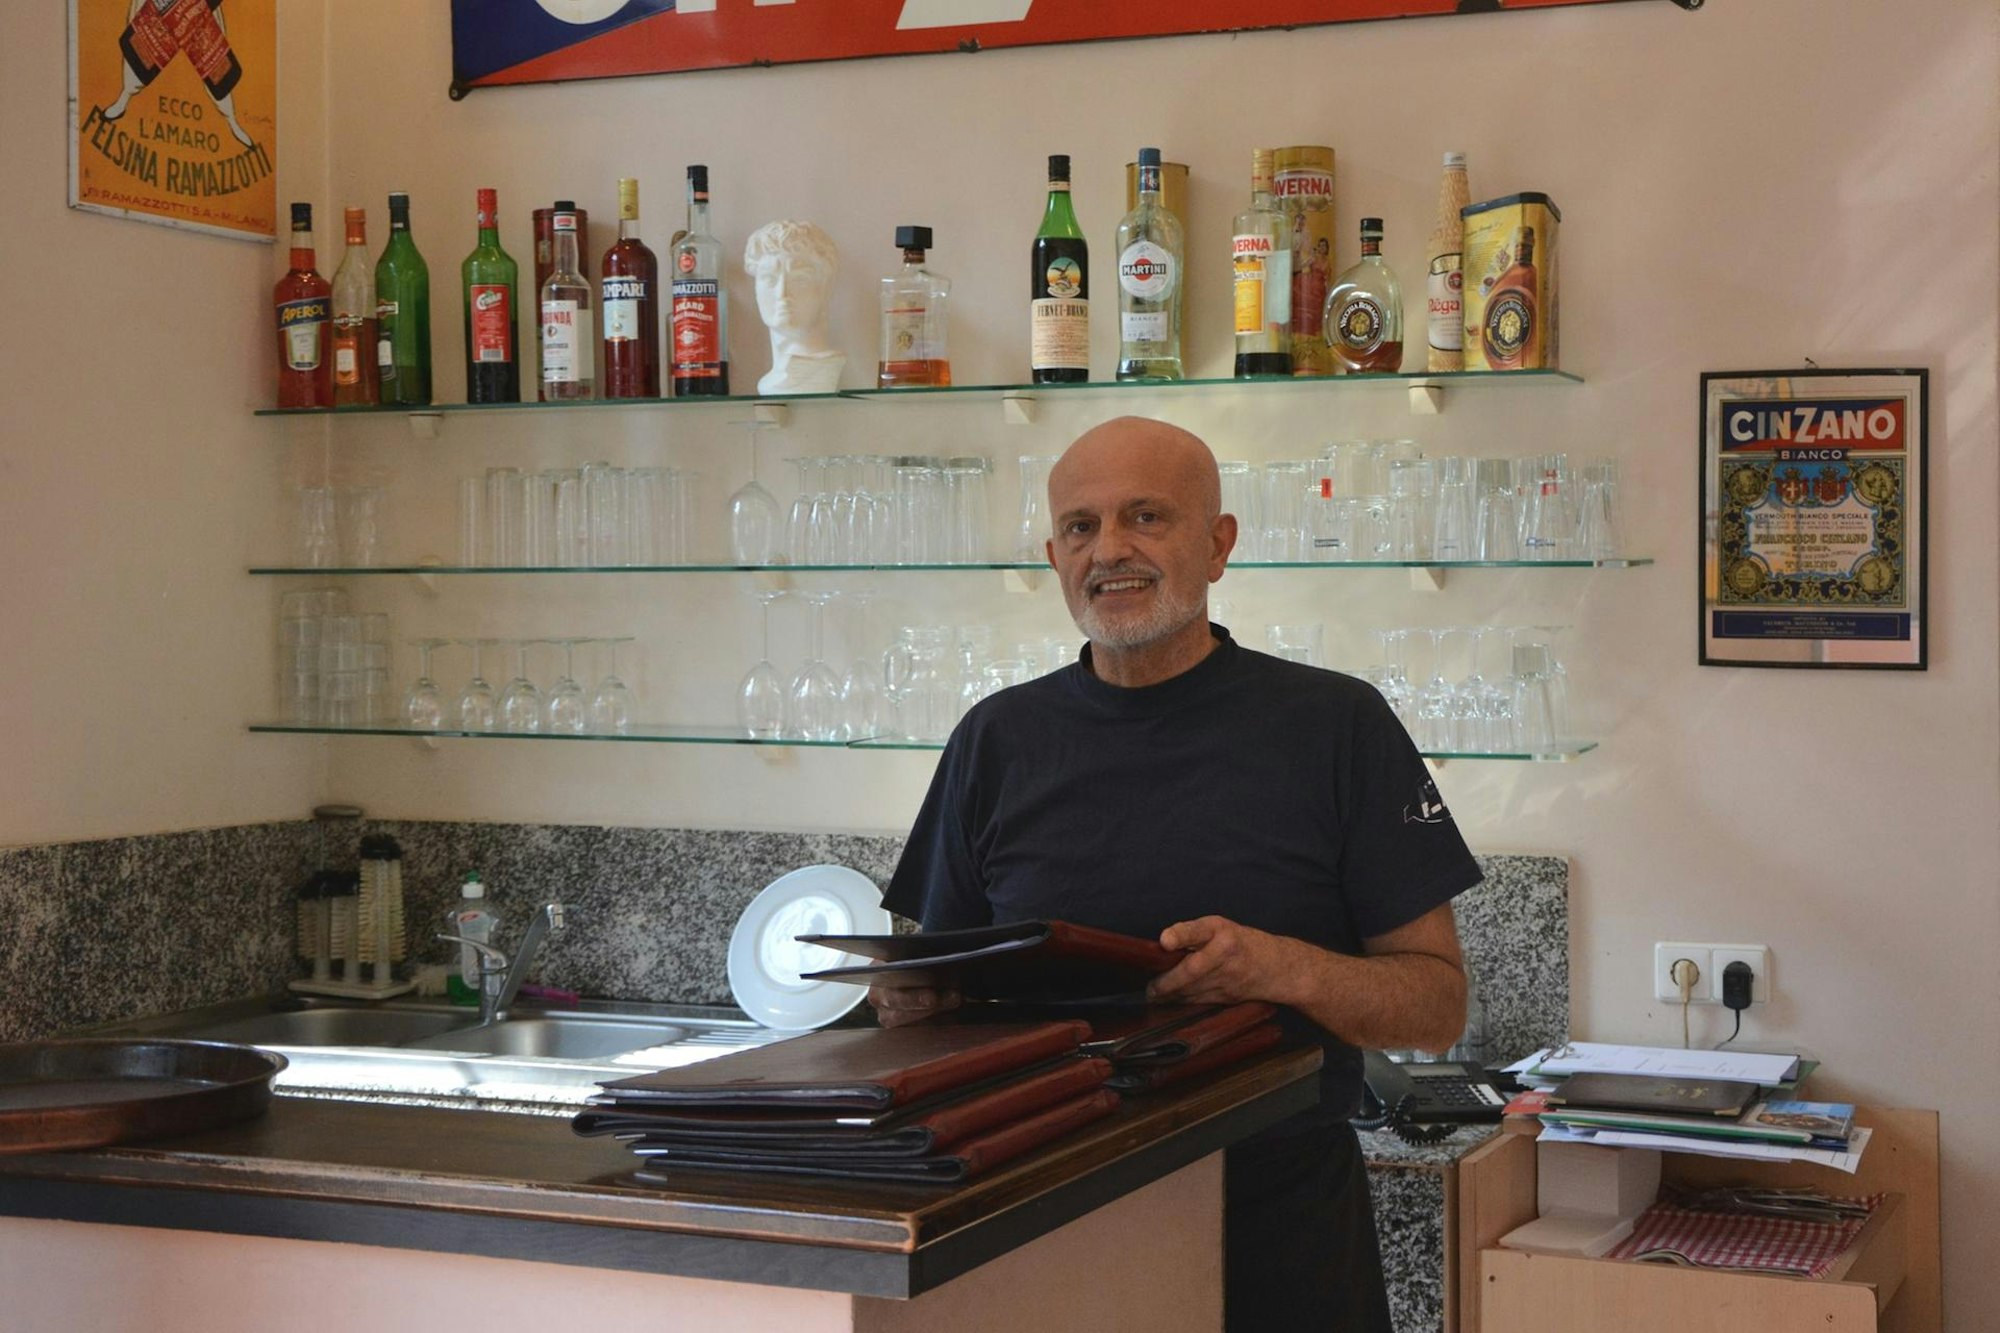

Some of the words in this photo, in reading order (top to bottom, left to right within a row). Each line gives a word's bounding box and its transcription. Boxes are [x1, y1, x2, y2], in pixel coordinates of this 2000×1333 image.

[158, 96, 203, 121] ECCO
[139, 118, 220, 153] L'AMARO
[81, 105, 158, 187] FELSINA
[166, 142, 273, 197] RAMAZZOTTI
[101, 189, 189, 214] RAMAZZOTTI
[1123, 264, 1166, 275] MARTINI
[281, 304, 326, 324] APEROL
[1037, 303, 1088, 317] FERNET-BRANC
[1729, 407, 1897, 443] CINZANO
[1780, 450, 1843, 460] BIANCO
[1831, 512, 1868, 520] SPECIALE
